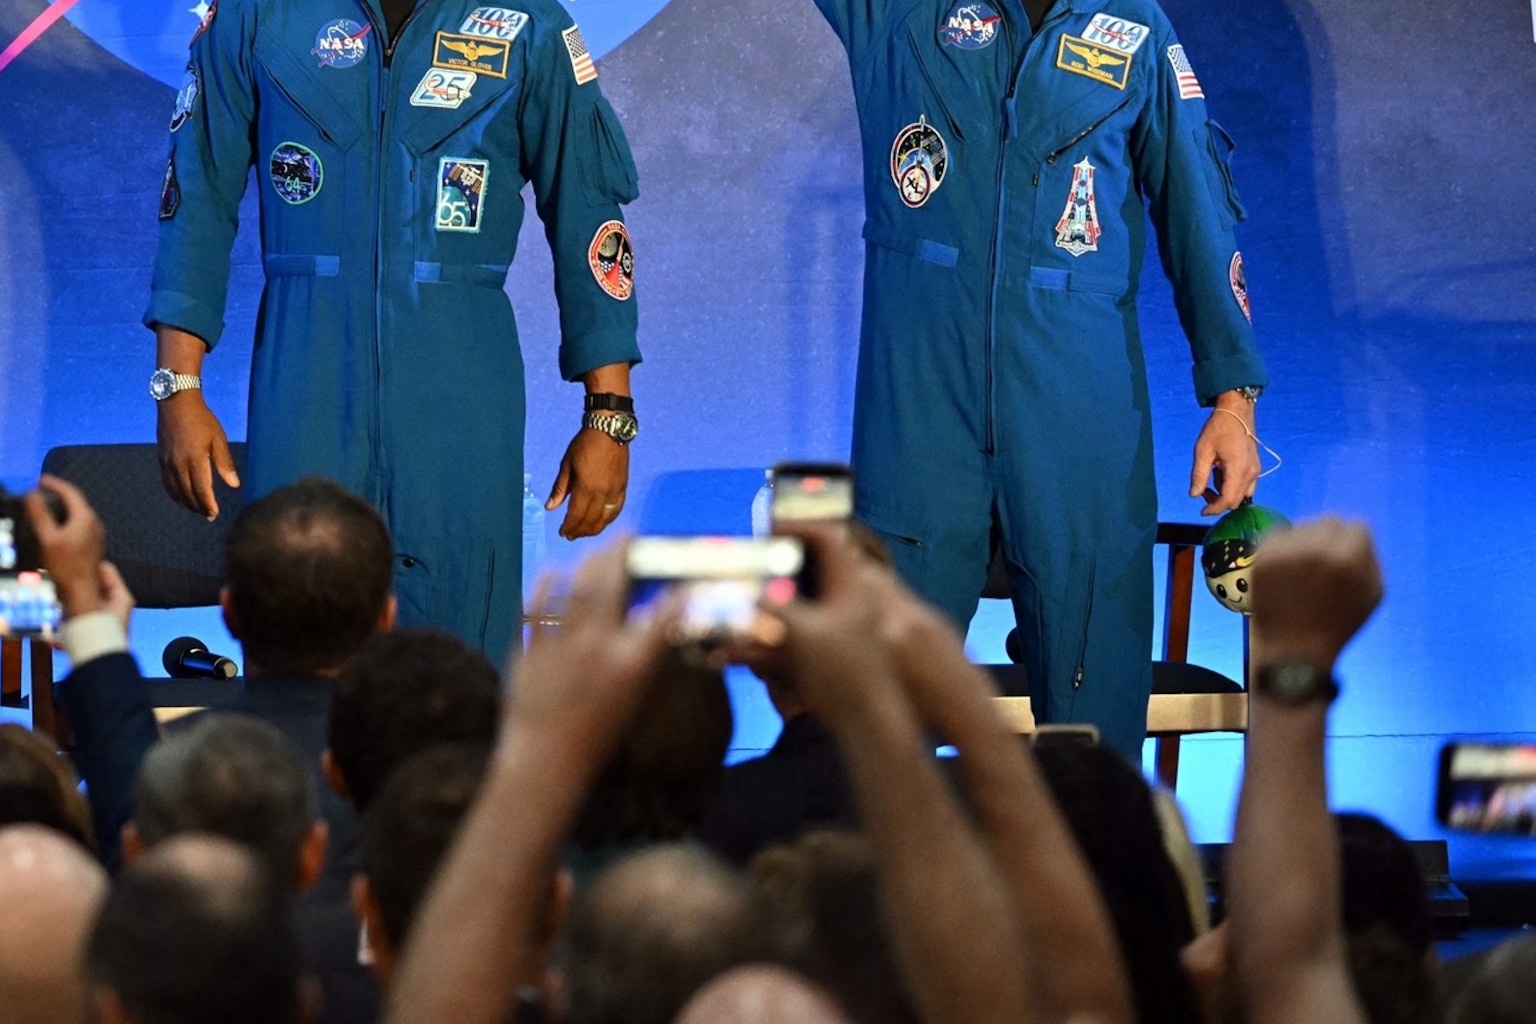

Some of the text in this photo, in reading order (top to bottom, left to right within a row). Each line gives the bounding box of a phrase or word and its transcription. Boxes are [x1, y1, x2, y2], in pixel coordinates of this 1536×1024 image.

[949, 17, 994, 34] NASA
[320, 38, 365, 50] NASA
[471, 61, 493, 71] GLOVER
[420, 74, 467, 102] 25
[440, 192, 467, 227] 65
